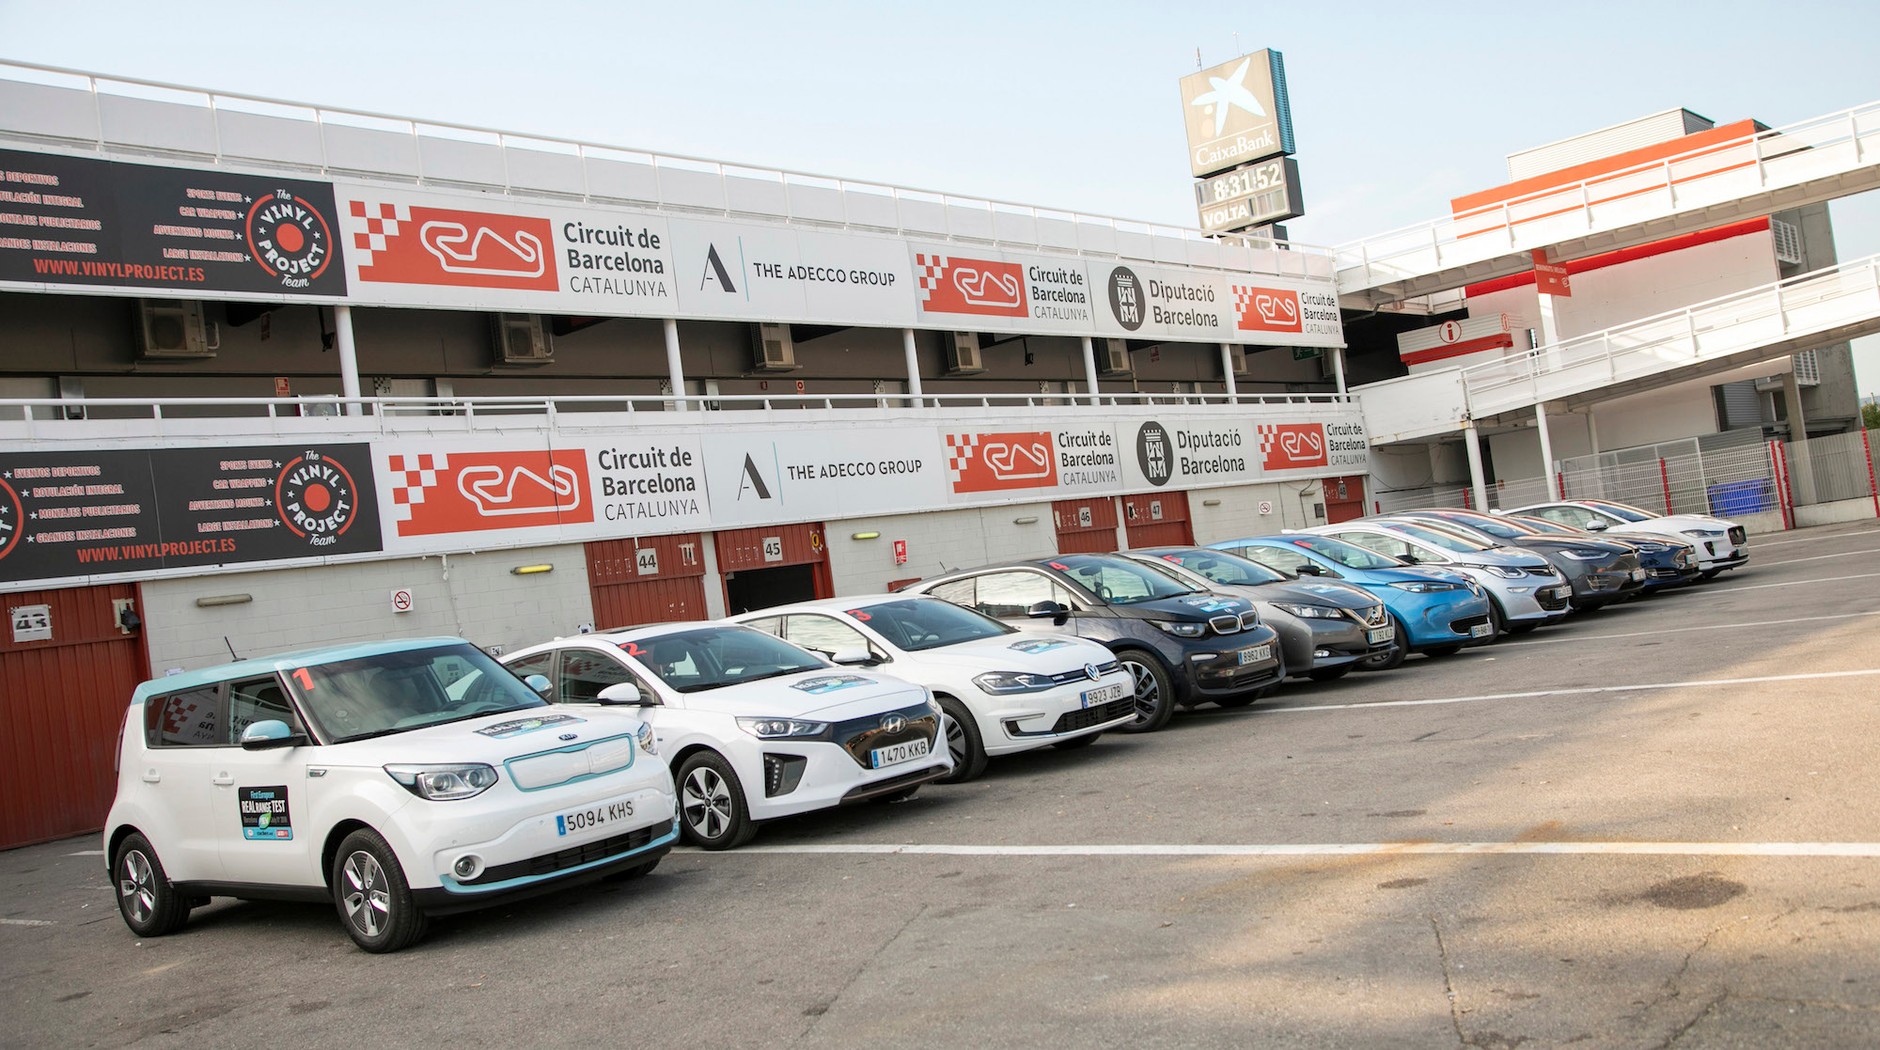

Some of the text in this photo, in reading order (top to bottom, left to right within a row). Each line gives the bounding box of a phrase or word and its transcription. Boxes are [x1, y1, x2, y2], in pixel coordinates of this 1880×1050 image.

[1196, 130, 1274, 165] CaixaBank
[6, 171, 59, 186] DEPORTIVOS
[1213, 163, 1282, 201] 8:31:52
[42, 195, 84, 208] INTEGRAL
[186, 188, 242, 202] SPORTS EVENTS
[276, 189, 292, 200] The
[179, 206, 237, 220] CAR WRAPPING
[260, 203, 314, 230] VINYL
[1203, 204, 1249, 227] VOLTA
[0, 213, 102, 230] ONTAJES PUBLICITARIOS
[153, 225, 235, 240] ADVERTISING MOUNTS
[563, 222, 661, 250] Circuit de
[32, 240, 97, 254] INSTALACIONES
[163, 248, 244, 262] LARGE INSTALLATIONS
[258, 239, 324, 274] PROJECT
[567, 249, 664, 275] Barcelona
[33, 259, 205, 282] WWW.VINYLPROJECT.ES
[753, 262, 896, 287] THE ADECCO GROUP
[1029, 266, 1083, 285] Circuit de
[281, 274, 310, 288] Team
[570, 276, 667, 297] CATALUNYA
[1032, 286, 1086, 304] Barcelona
[1149, 280, 1215, 303] Diputació
[1301, 292, 1335, 307] Circuit de
[1034, 306, 1088, 321] CATALUNYA
[1153, 306, 1219, 327] Barcelona
[1304, 307, 1337, 322] Barcelona
[1305, 323, 1339, 335] CATALUNYA
[1326, 422, 1362, 437] Circuit de
[1058, 431, 1112, 448] Circuit de
[1177, 428, 1242, 452] Diputació
[1329, 437, 1366, 451] Barcelona
[305, 450, 320, 461] The
[598, 446, 692, 471] Circuit de
[1061, 450, 1114, 467] Barcelona
[1331, 453, 1367, 466] CATALUNYA
[14, 466, 101, 478] EVENTOS DEPORTIVOS
[220, 459, 273, 471] SPORTS EVENTS
[787, 459, 923, 480] THE ADECCO GROUP
[1181, 455, 1245, 475] Barcelona
[289, 464, 340, 488] VINYL
[1063, 469, 1117, 486] CATALUNYA
[33, 484, 124, 498] ROTULACIÓN INTEGRAL
[212, 478, 267, 490] CAR WRAPPING
[603, 473, 696, 496] Barcelona
[38, 504, 141, 519] MONTAJES PUBLICITARIOS
[189, 497, 265, 511] ADVERTISING MOUNTS
[604, 499, 699, 521] CATALUNYA
[1152, 505, 1160, 515] 47
[287, 500, 350, 532] PROJECT
[1081, 512, 1091, 522] 46
[198, 519, 274, 533] LARGE INSTALLATIONS
[36, 527, 137, 543] GRANDES INSTALACIONES
[309, 533, 337, 546] Team
[77, 538, 236, 563] WWW.VINYLPROJECT.ES
[765, 543, 780, 556] 45
[639, 555, 656, 568] 44
[1049, 562, 1069, 571] 4
[848, 610, 872, 621] 3
[619, 643, 647, 657] 2
[293, 668, 314, 691] 1
[1088, 686, 1121, 705] 9923 JZB
[881, 741, 927, 764] 1470 KKB
[241, 800, 285, 813] REAL RANGE TEST
[567, 801, 633, 831] 5094 KHS
